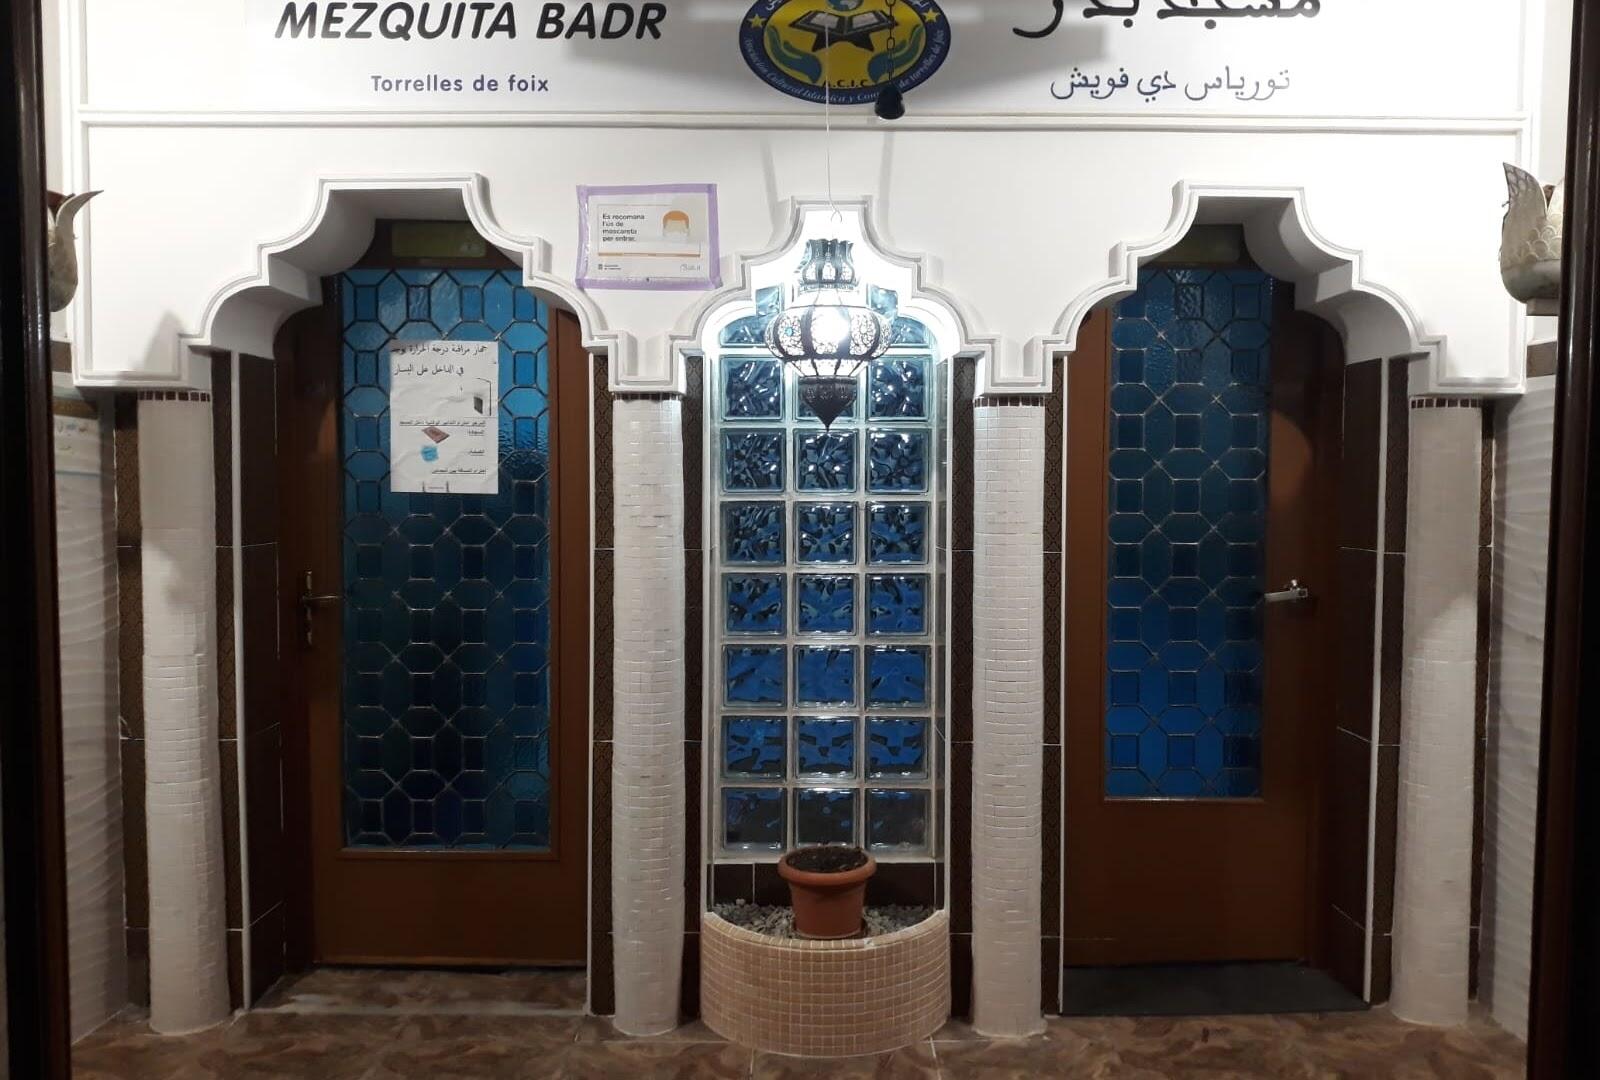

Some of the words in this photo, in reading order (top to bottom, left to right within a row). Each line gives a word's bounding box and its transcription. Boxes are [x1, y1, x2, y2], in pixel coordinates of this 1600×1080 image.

[275, 1, 517, 41] MEZQUITA
[536, 1, 667, 40] BADR
[371, 74, 463, 92] Torrelles
[473, 74, 499, 92] de
[507, 74, 549, 92] foix
[1050, 66, 1130, 101] فويش
[1136, 70, 1177, 103] دي
[1184, 65, 1291, 101] تورياس
